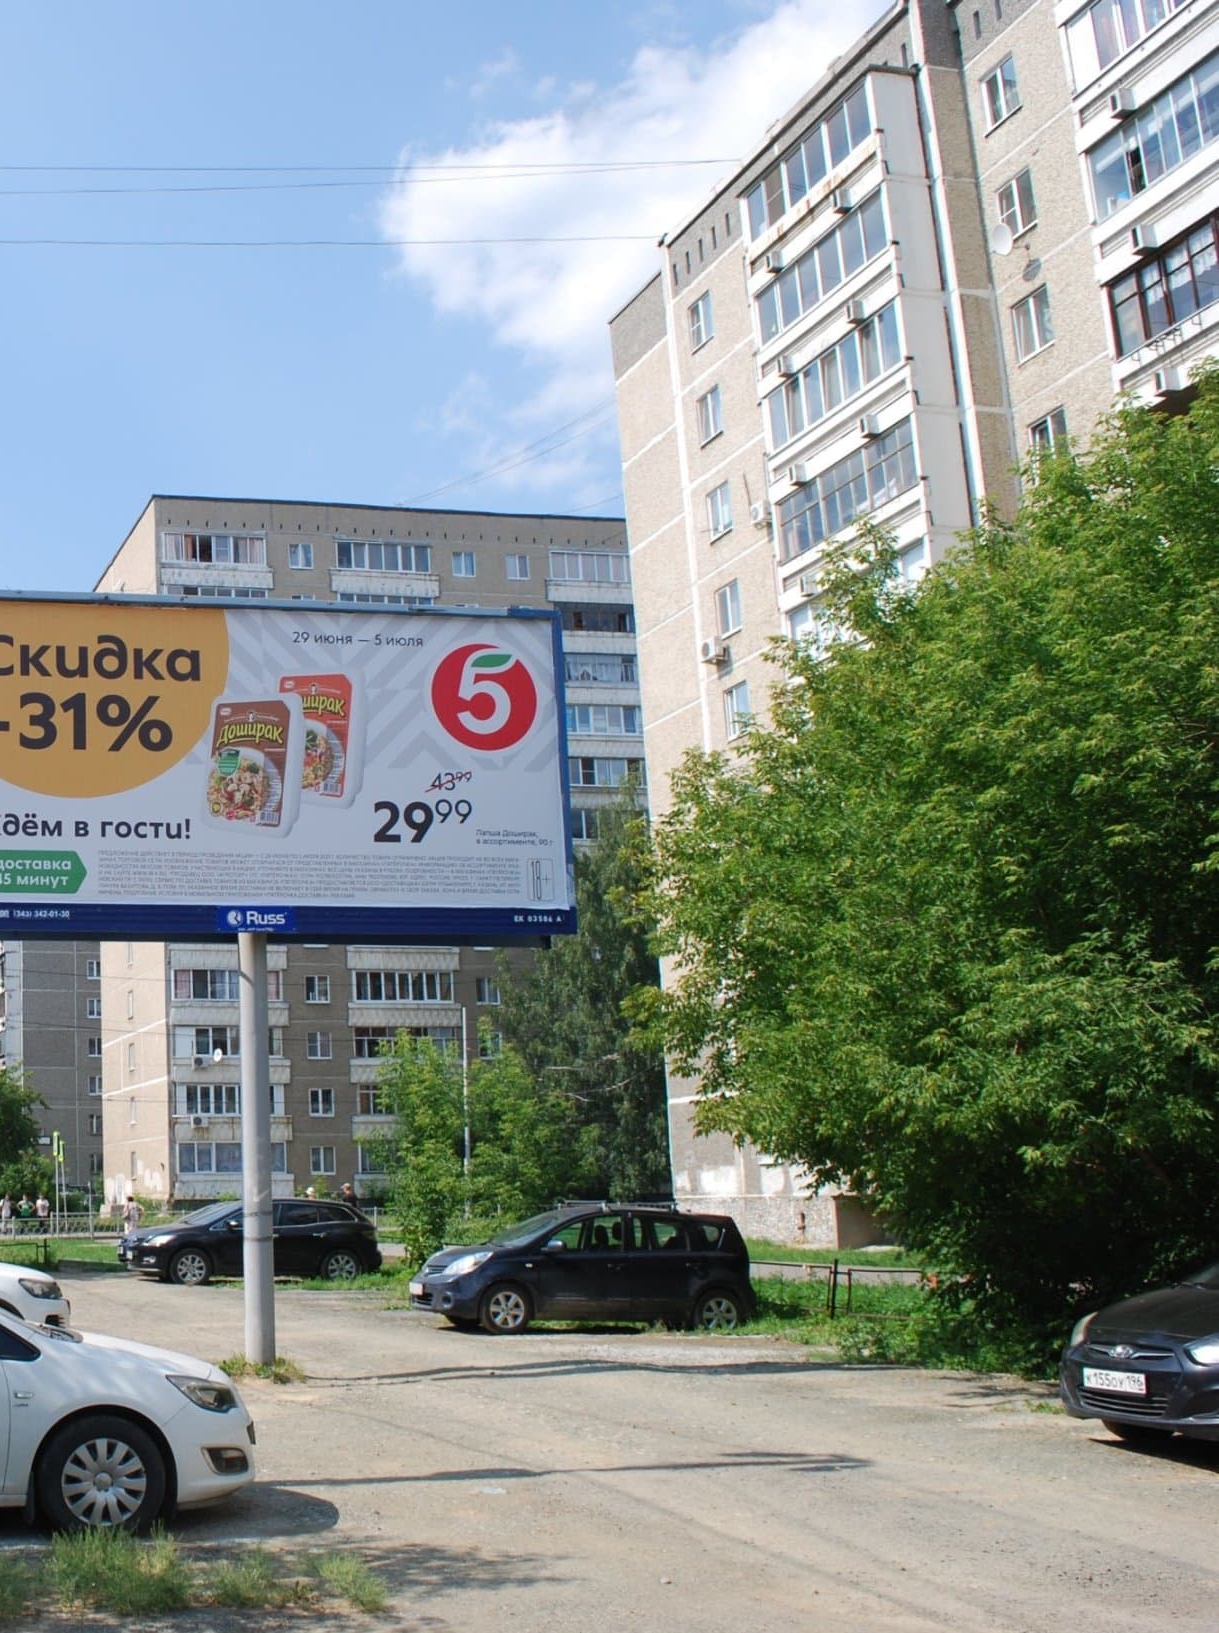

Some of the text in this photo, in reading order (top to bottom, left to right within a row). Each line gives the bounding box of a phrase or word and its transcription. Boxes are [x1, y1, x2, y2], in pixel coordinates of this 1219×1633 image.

[292, 632, 310, 644] 29
[314, 634, 353, 645] июня
[374, 634, 382, 646] 5
[385, 636, 423, 647] июля
[216, 721, 284, 748] Доширак
[75, 821, 90, 838] в
[100, 818, 191, 840] гости!
[16, 875, 69, 889] минут
[246, 911, 286, 925] Russ
